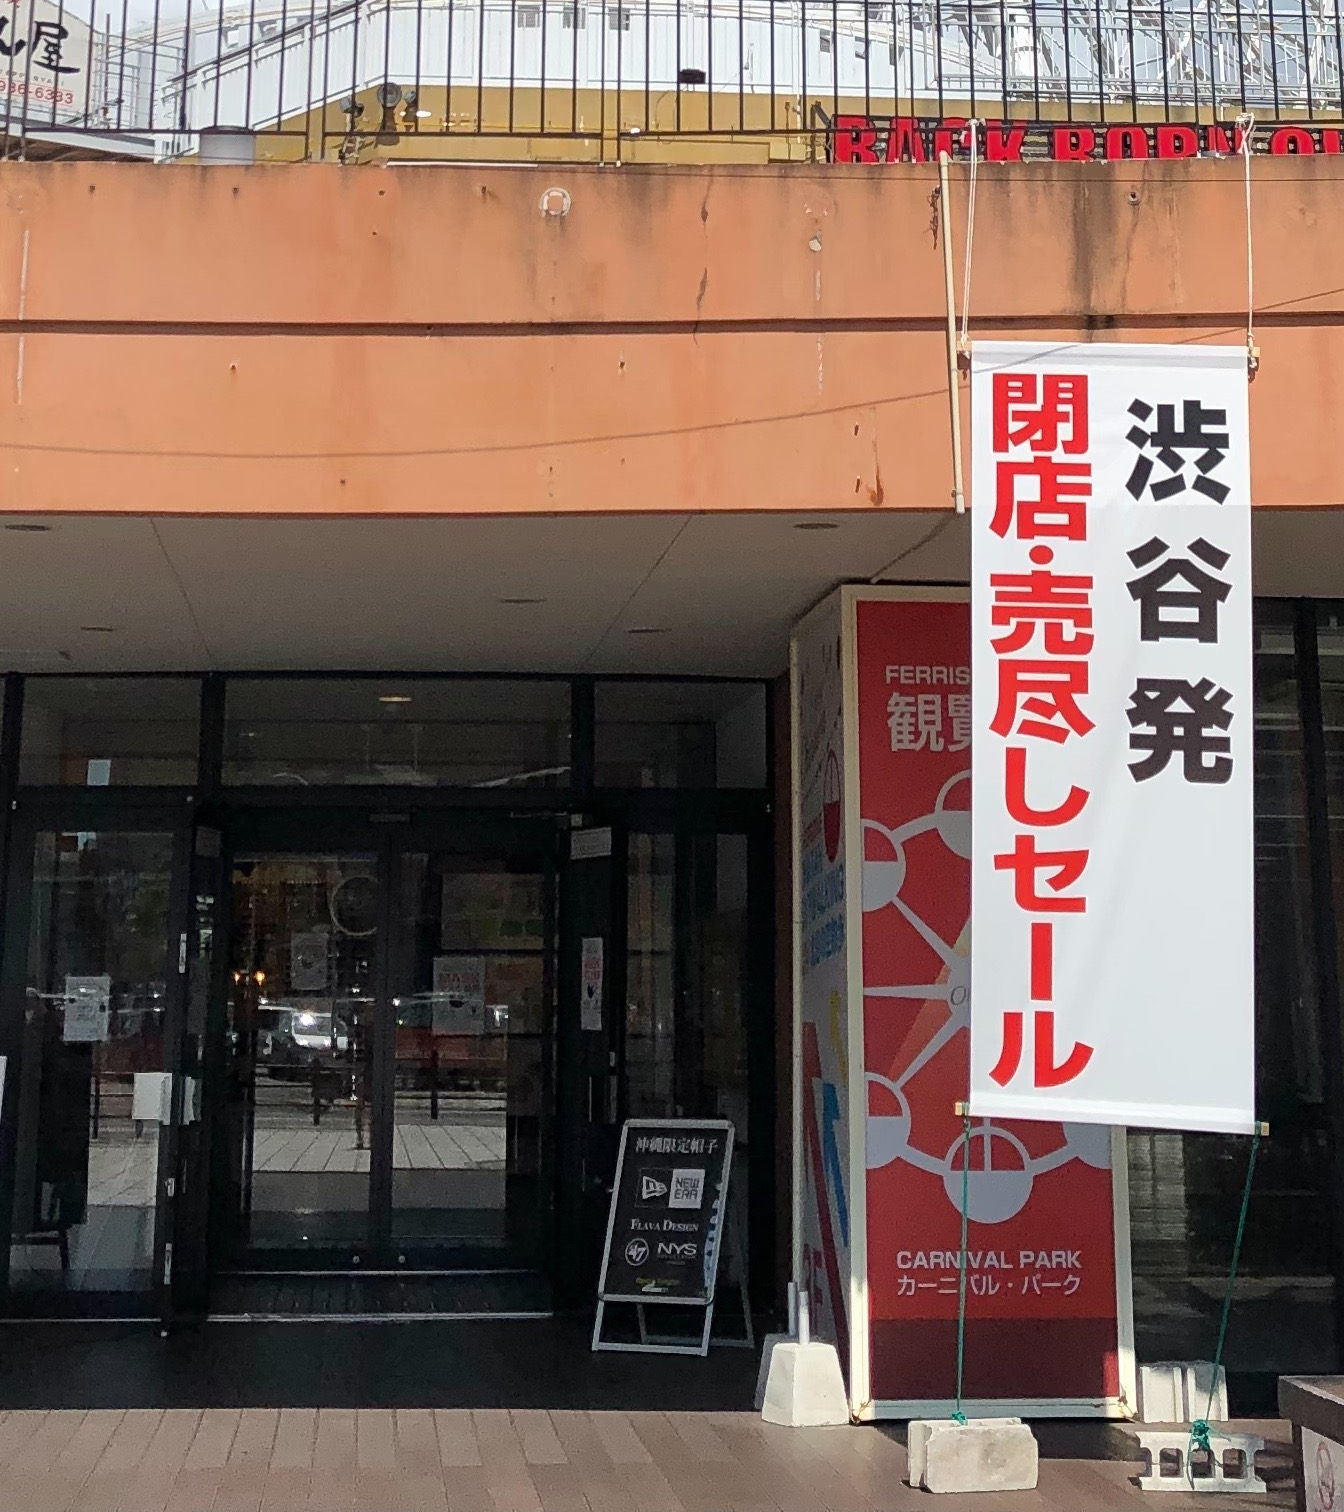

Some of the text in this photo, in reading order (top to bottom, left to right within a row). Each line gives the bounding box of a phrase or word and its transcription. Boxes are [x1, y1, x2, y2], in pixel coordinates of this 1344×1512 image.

[1126, 398, 1234, 784] 渋谷発
[885, 665, 971, 686] FERRIS
[989, 373, 1095, 1089] 閉店・売尽しセール
[635, 1136, 719, 1154] 沖縄限定帽子
[676, 1177, 700, 1189] NEW
[674, 1188, 698, 1200] ERA
[657, 1242, 698, 1256] NYS
[896, 1250, 1083, 1270] CARNVAL PARK
[897, 1274, 1082, 1297] カーニバル・パーク
